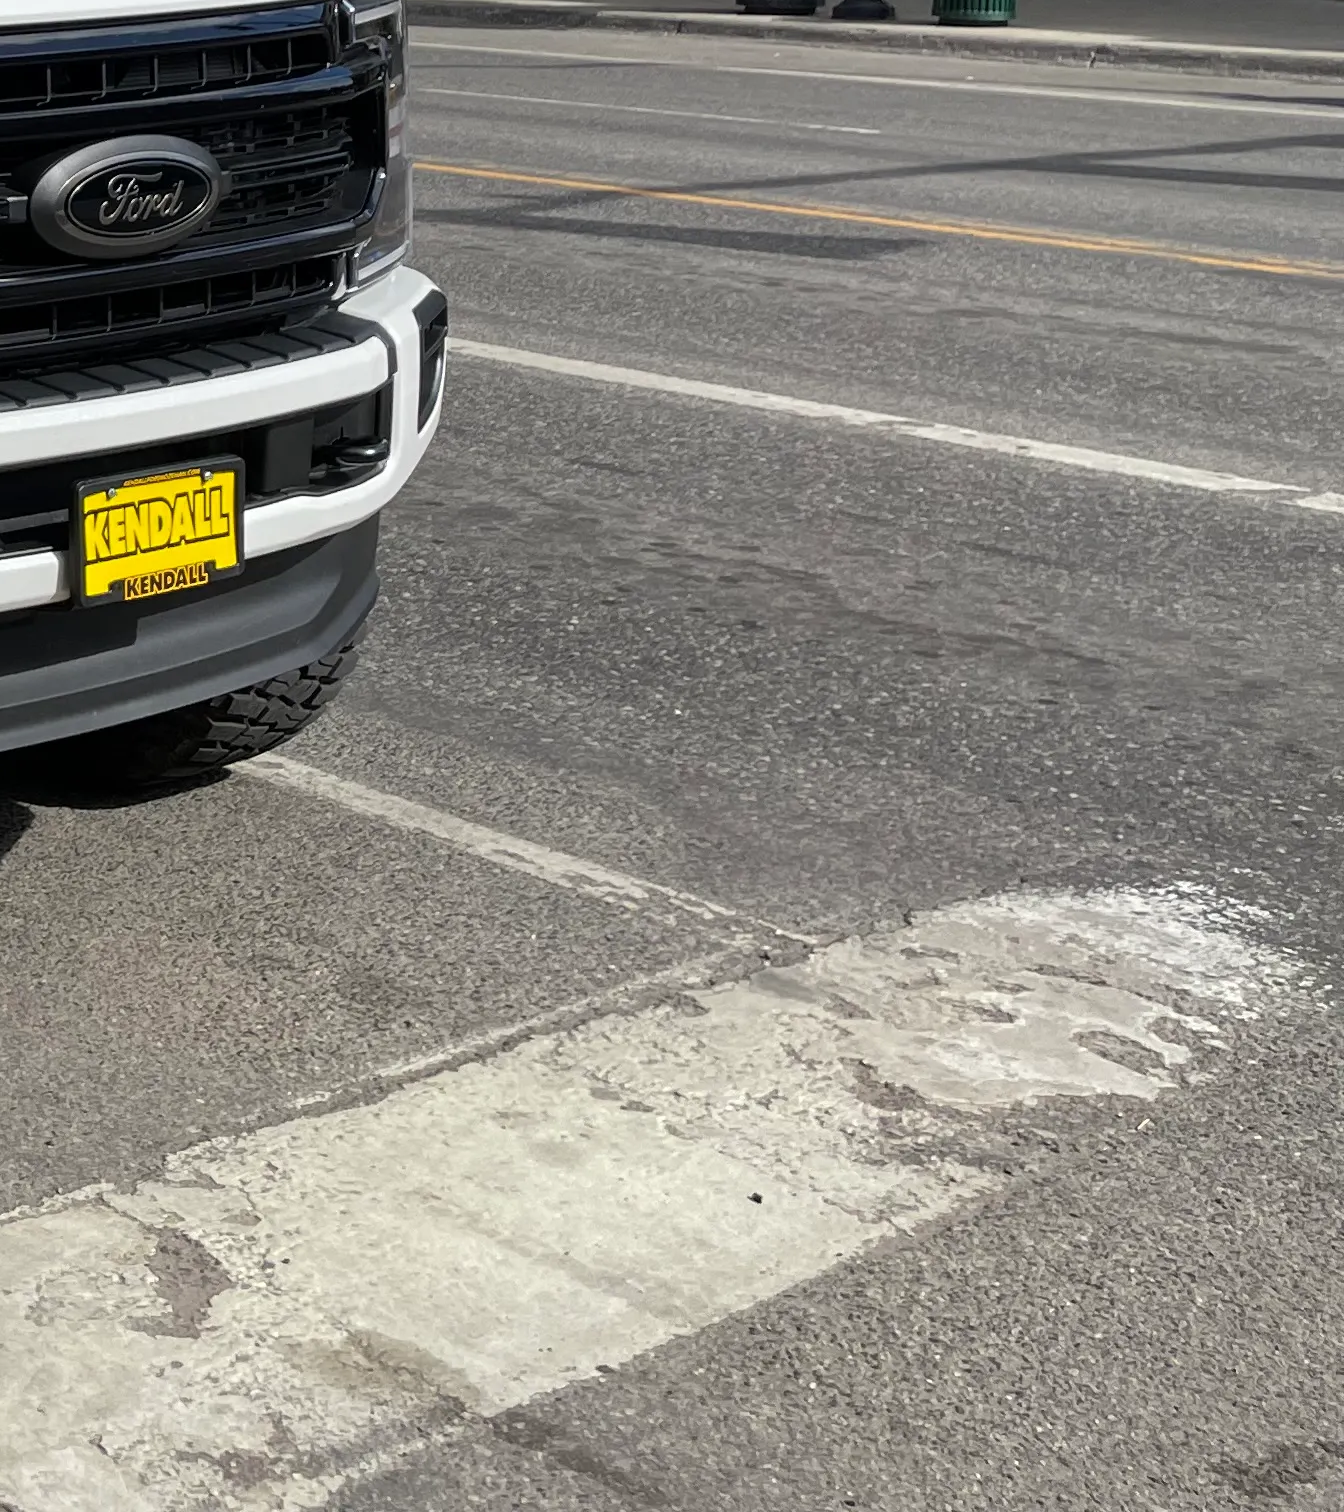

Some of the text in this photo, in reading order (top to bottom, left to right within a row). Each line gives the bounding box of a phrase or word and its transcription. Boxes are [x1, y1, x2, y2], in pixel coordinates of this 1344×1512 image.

[99, 171, 185, 226] Ford
[85, 487, 230, 564] KENDALL
[125, 562, 209, 600] KENDALL
